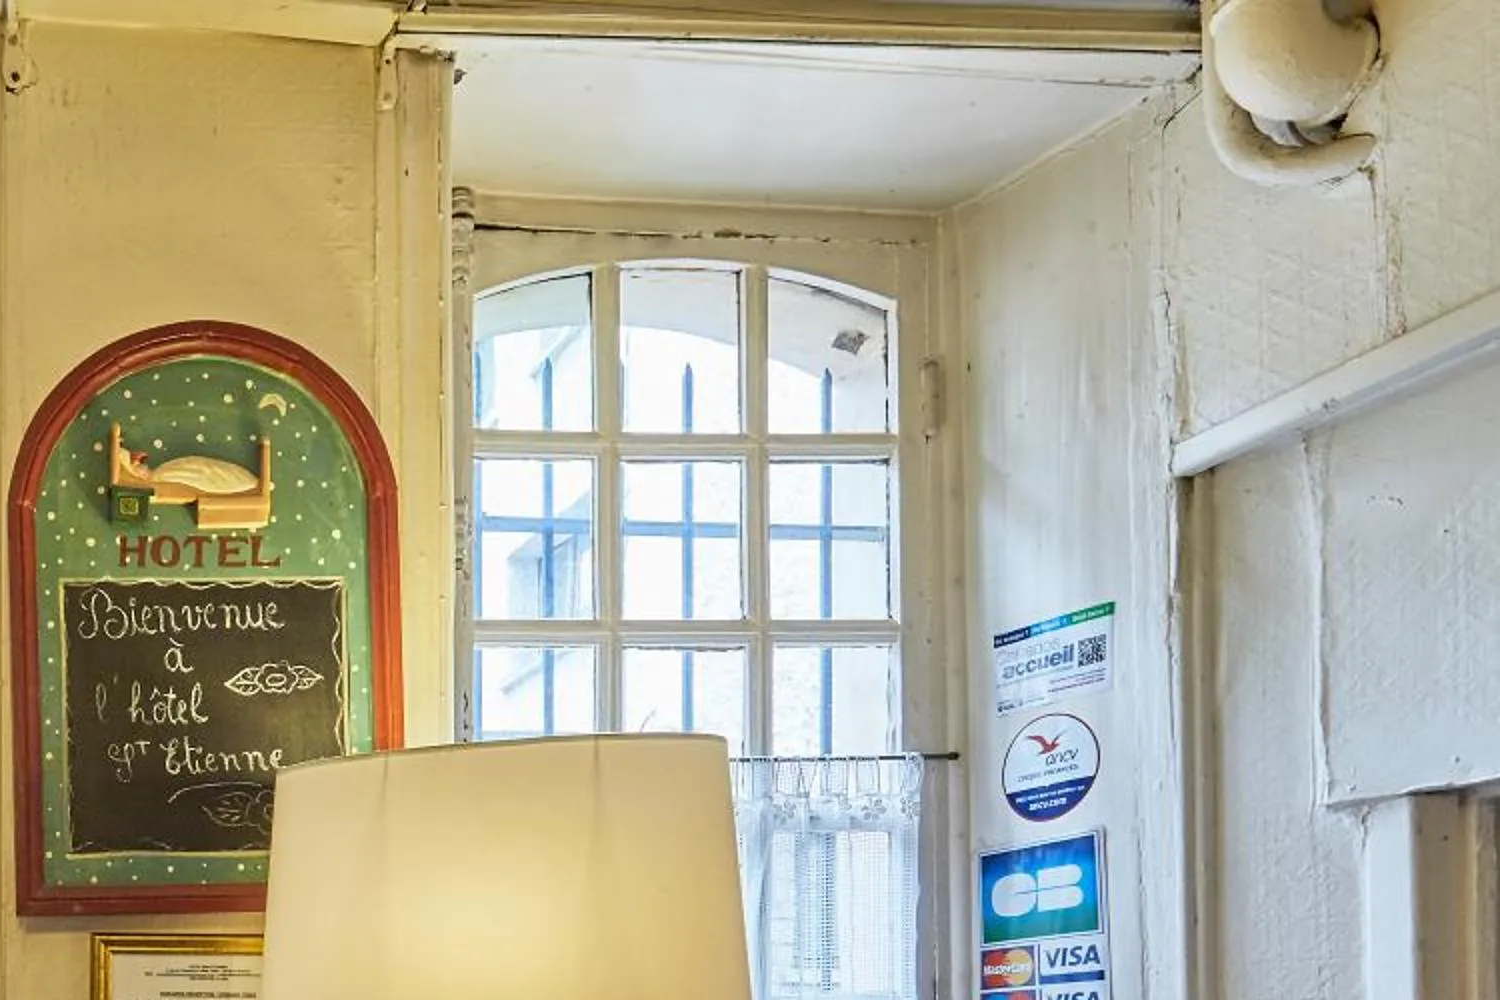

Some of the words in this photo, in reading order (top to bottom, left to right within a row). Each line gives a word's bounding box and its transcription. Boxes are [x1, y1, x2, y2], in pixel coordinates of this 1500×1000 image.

[118, 535, 281, 568] HOTEL
[79, 589, 286, 639] Bienvenue
[163, 638, 194, 675] à
[1002, 643, 1075, 679] accueil
[1046, 944, 1101, 968] VISA
